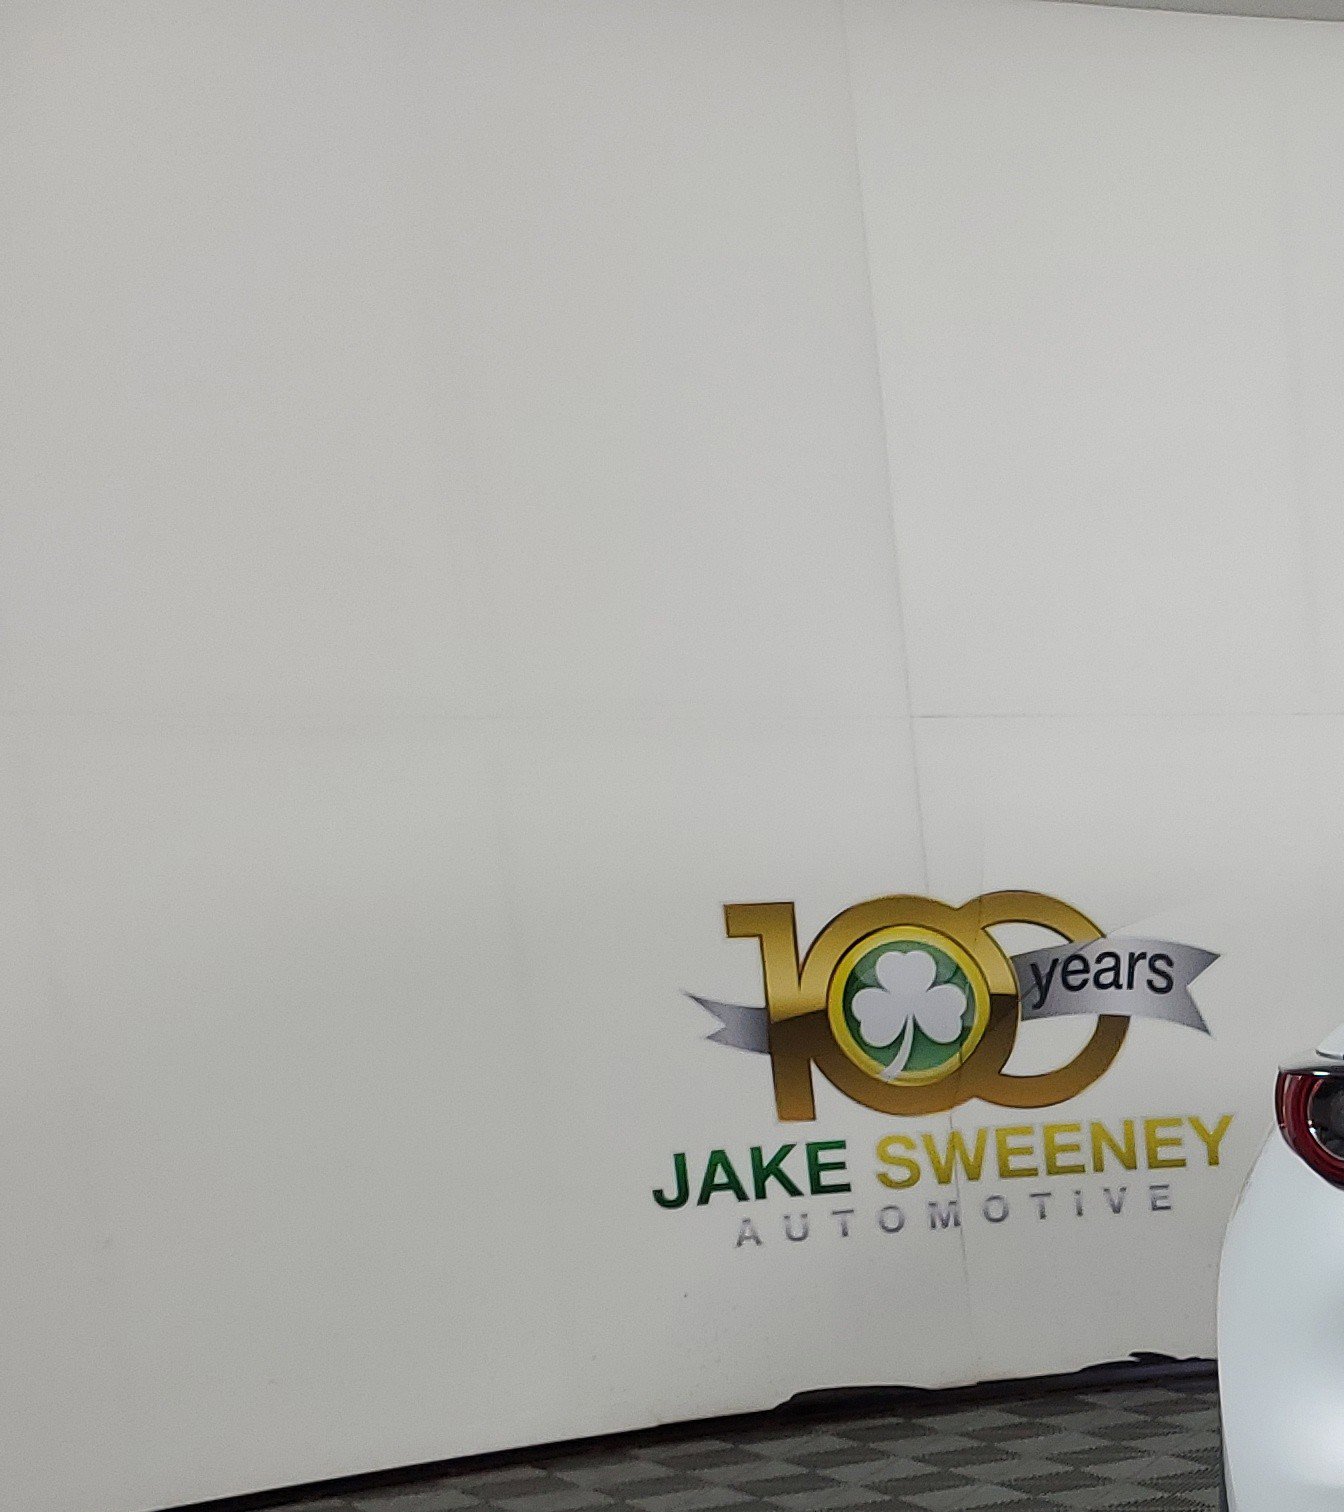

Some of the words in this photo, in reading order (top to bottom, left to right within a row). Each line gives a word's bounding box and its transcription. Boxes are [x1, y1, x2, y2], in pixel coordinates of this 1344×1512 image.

[1029, 948, 1176, 1011] years
[651, 1138, 853, 1211] JAKE
[874, 1114, 1236, 1192] SWEENEY
[734, 1183, 1174, 1248] AUTOMOTIVE
